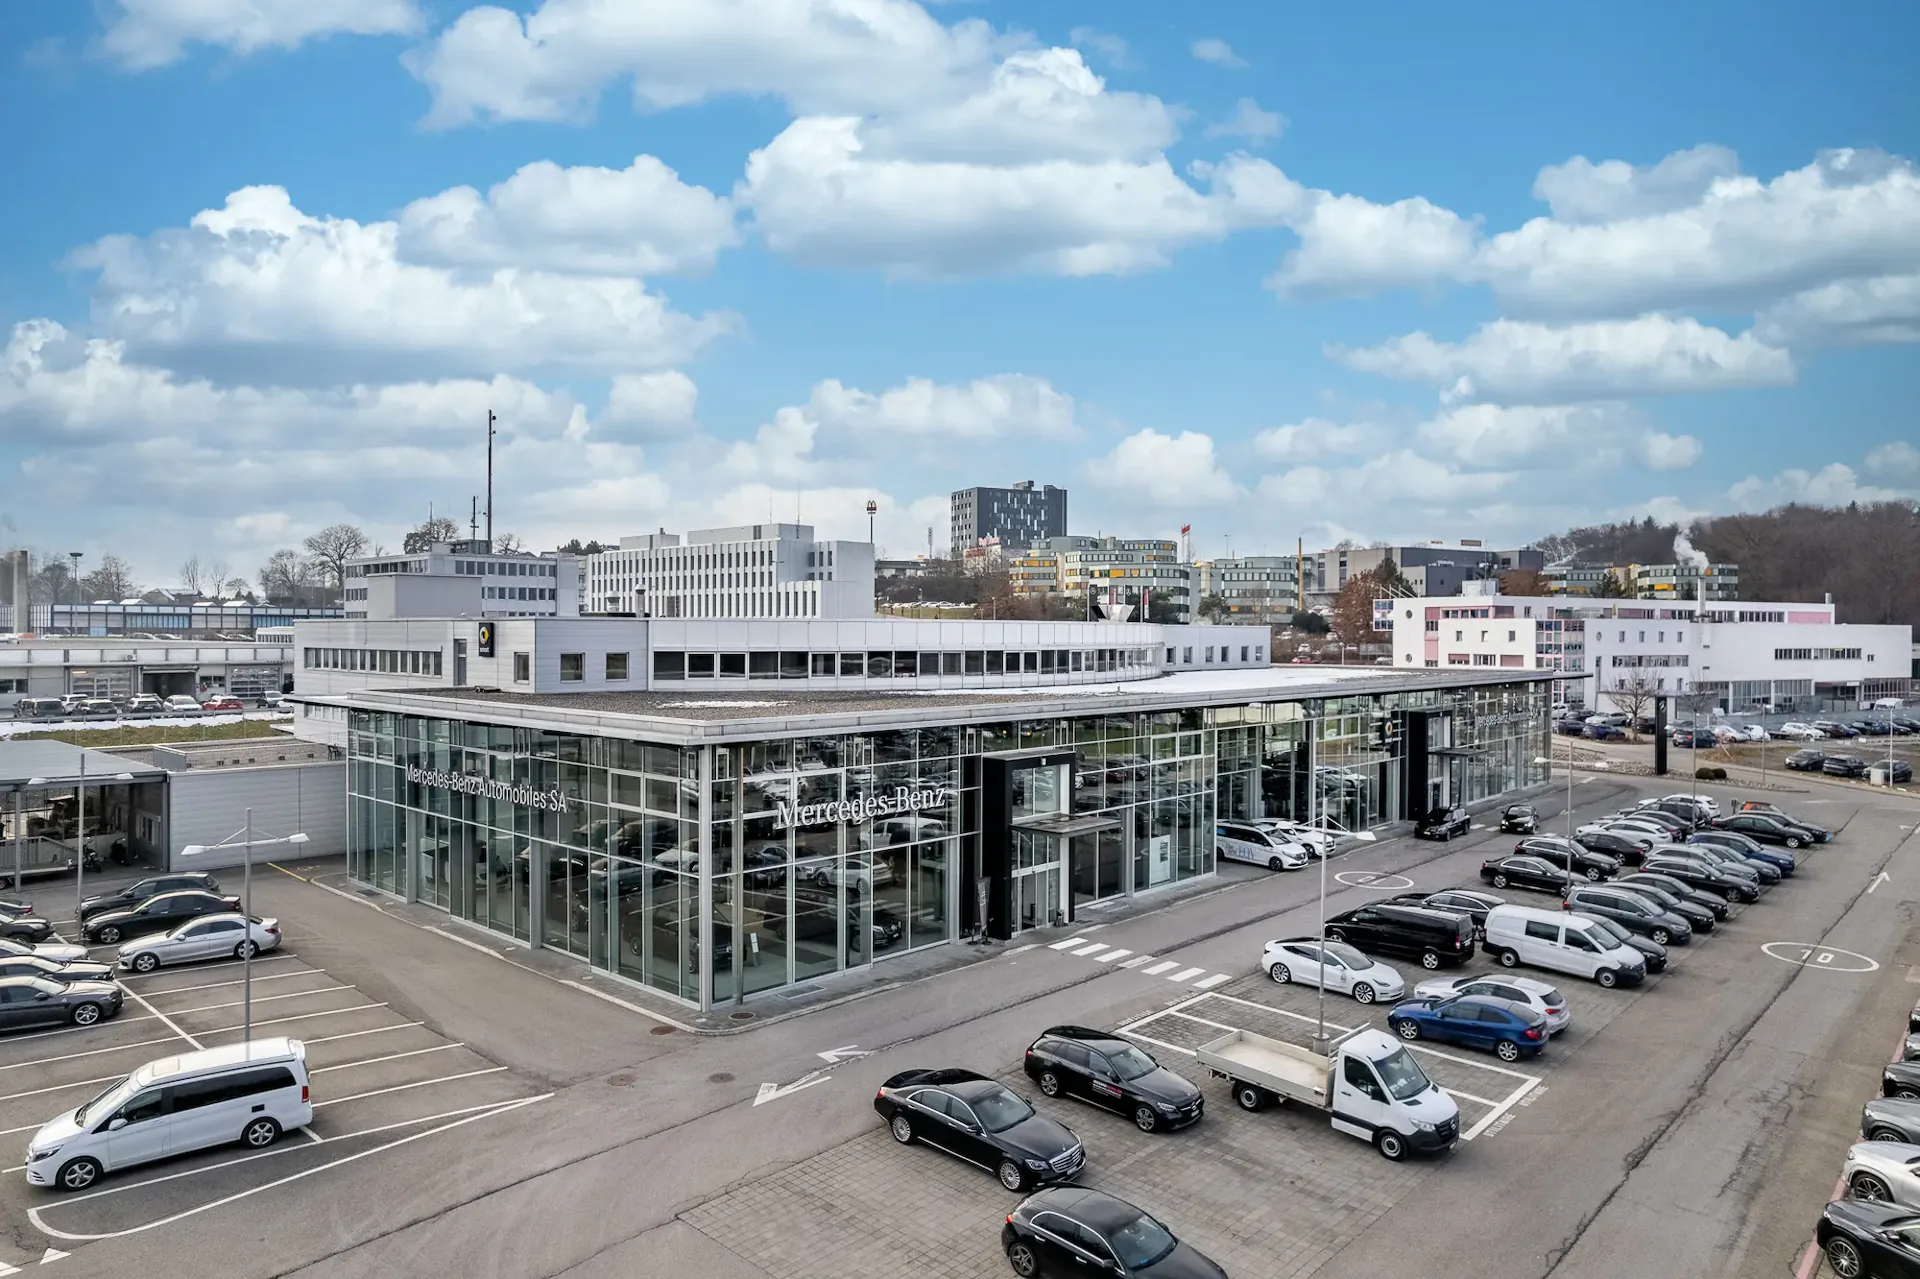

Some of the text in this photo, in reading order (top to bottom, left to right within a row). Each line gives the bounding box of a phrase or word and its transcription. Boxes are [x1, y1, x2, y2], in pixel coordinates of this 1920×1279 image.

[406, 763, 568, 813] Mercedes-Benz Automobiles SA
[773, 786, 947, 830] Mercedes-Benz
[1800, 949, 1835, 964] 10
